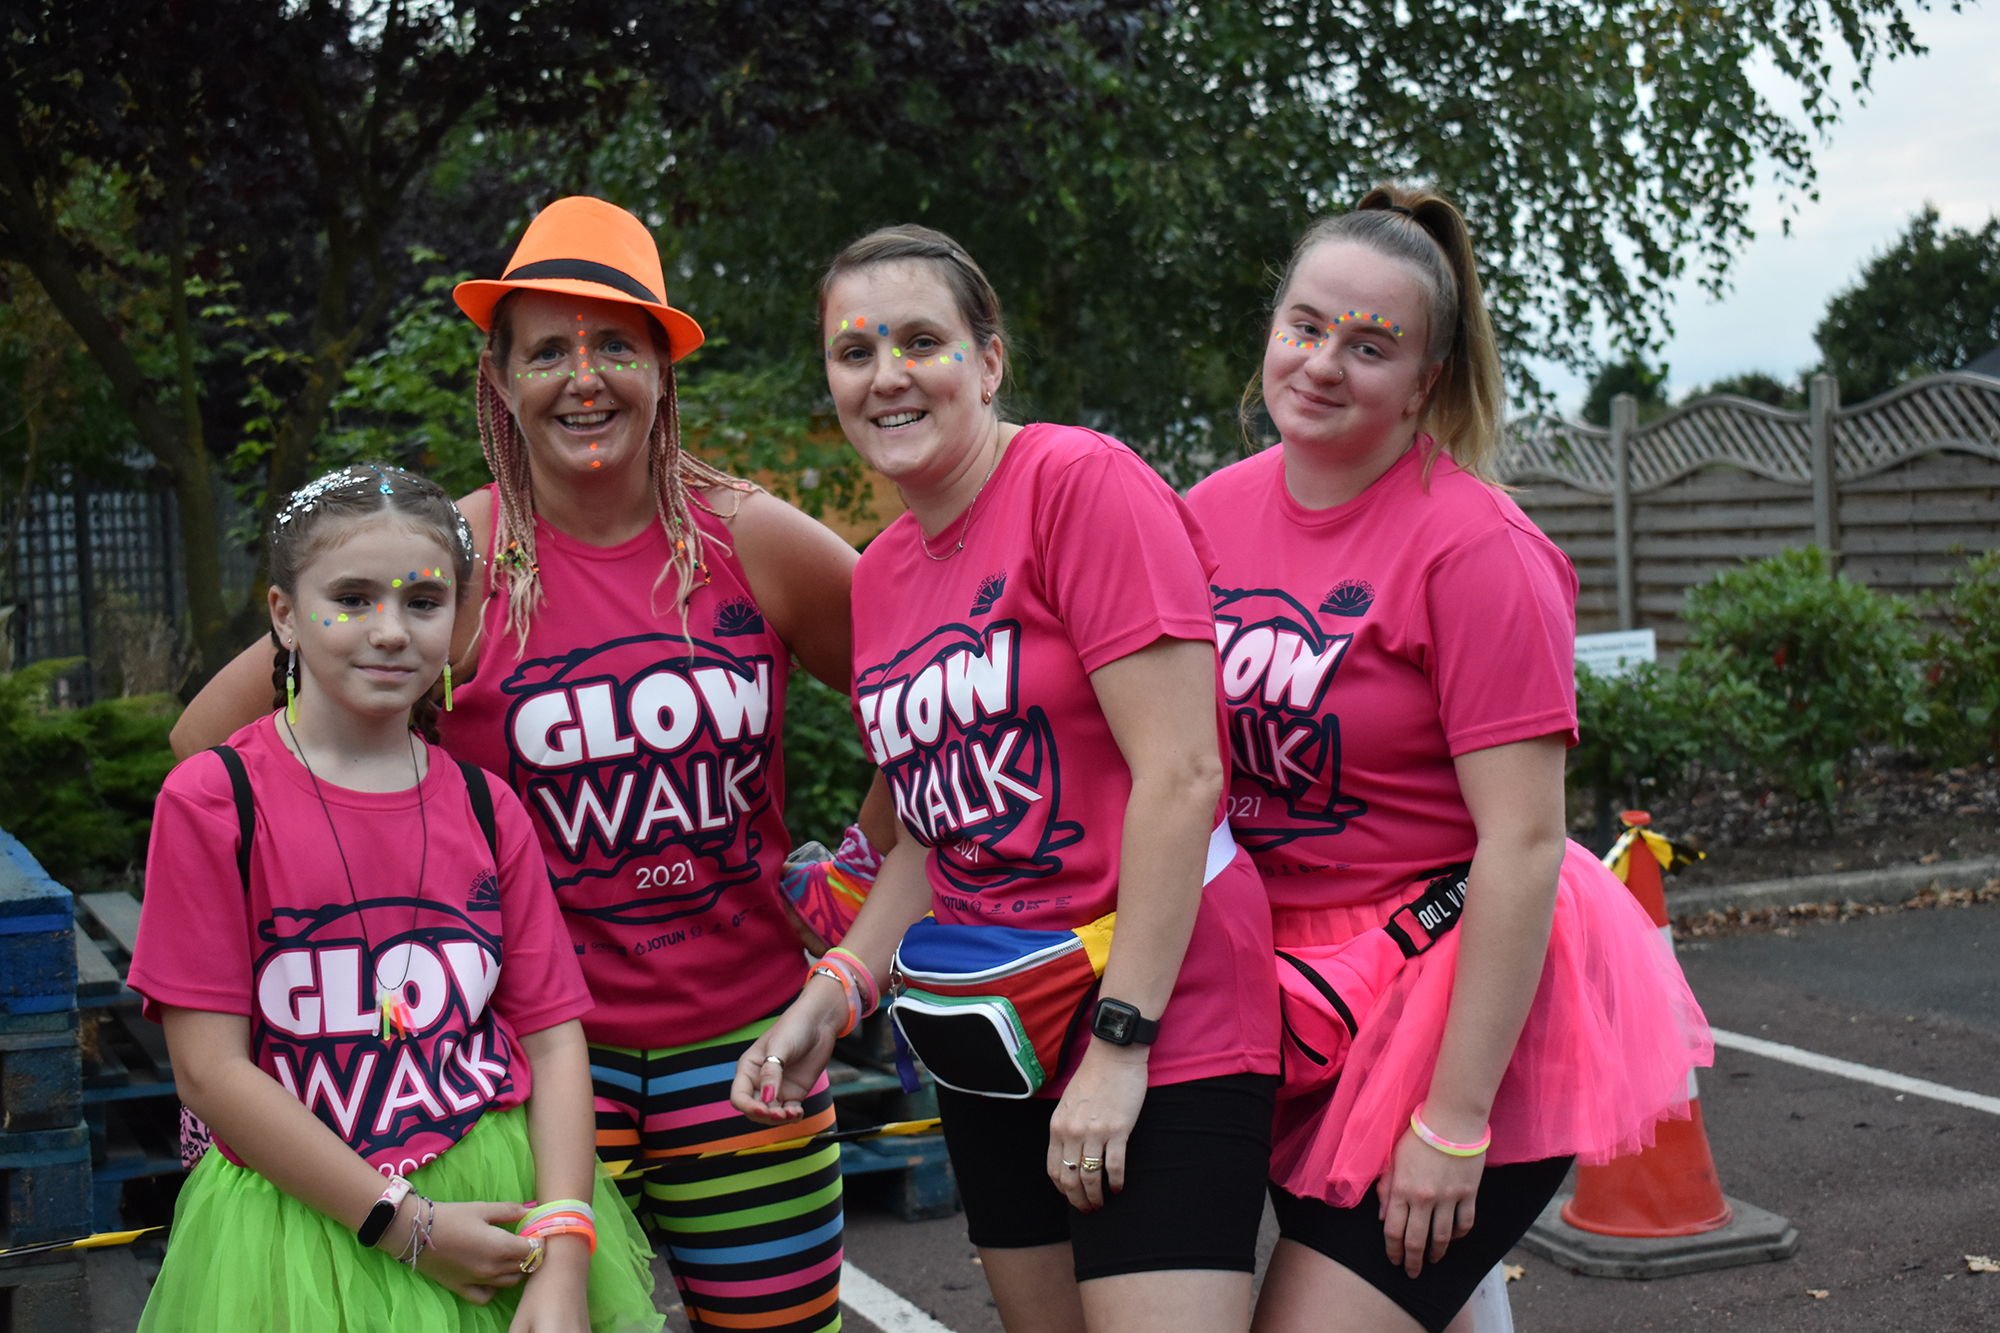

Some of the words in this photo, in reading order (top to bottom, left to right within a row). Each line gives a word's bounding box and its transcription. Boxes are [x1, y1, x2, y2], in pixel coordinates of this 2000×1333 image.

[515, 663, 769, 767] GLOW
[537, 753, 762, 853] WALK
[468, 868, 492, 900] LINDSEY
[635, 859, 695, 890] 2021
[1415, 900, 1452, 930] OOL
[647, 930, 686, 952] JOTUN
[274, 1033, 506, 1138] WALK
